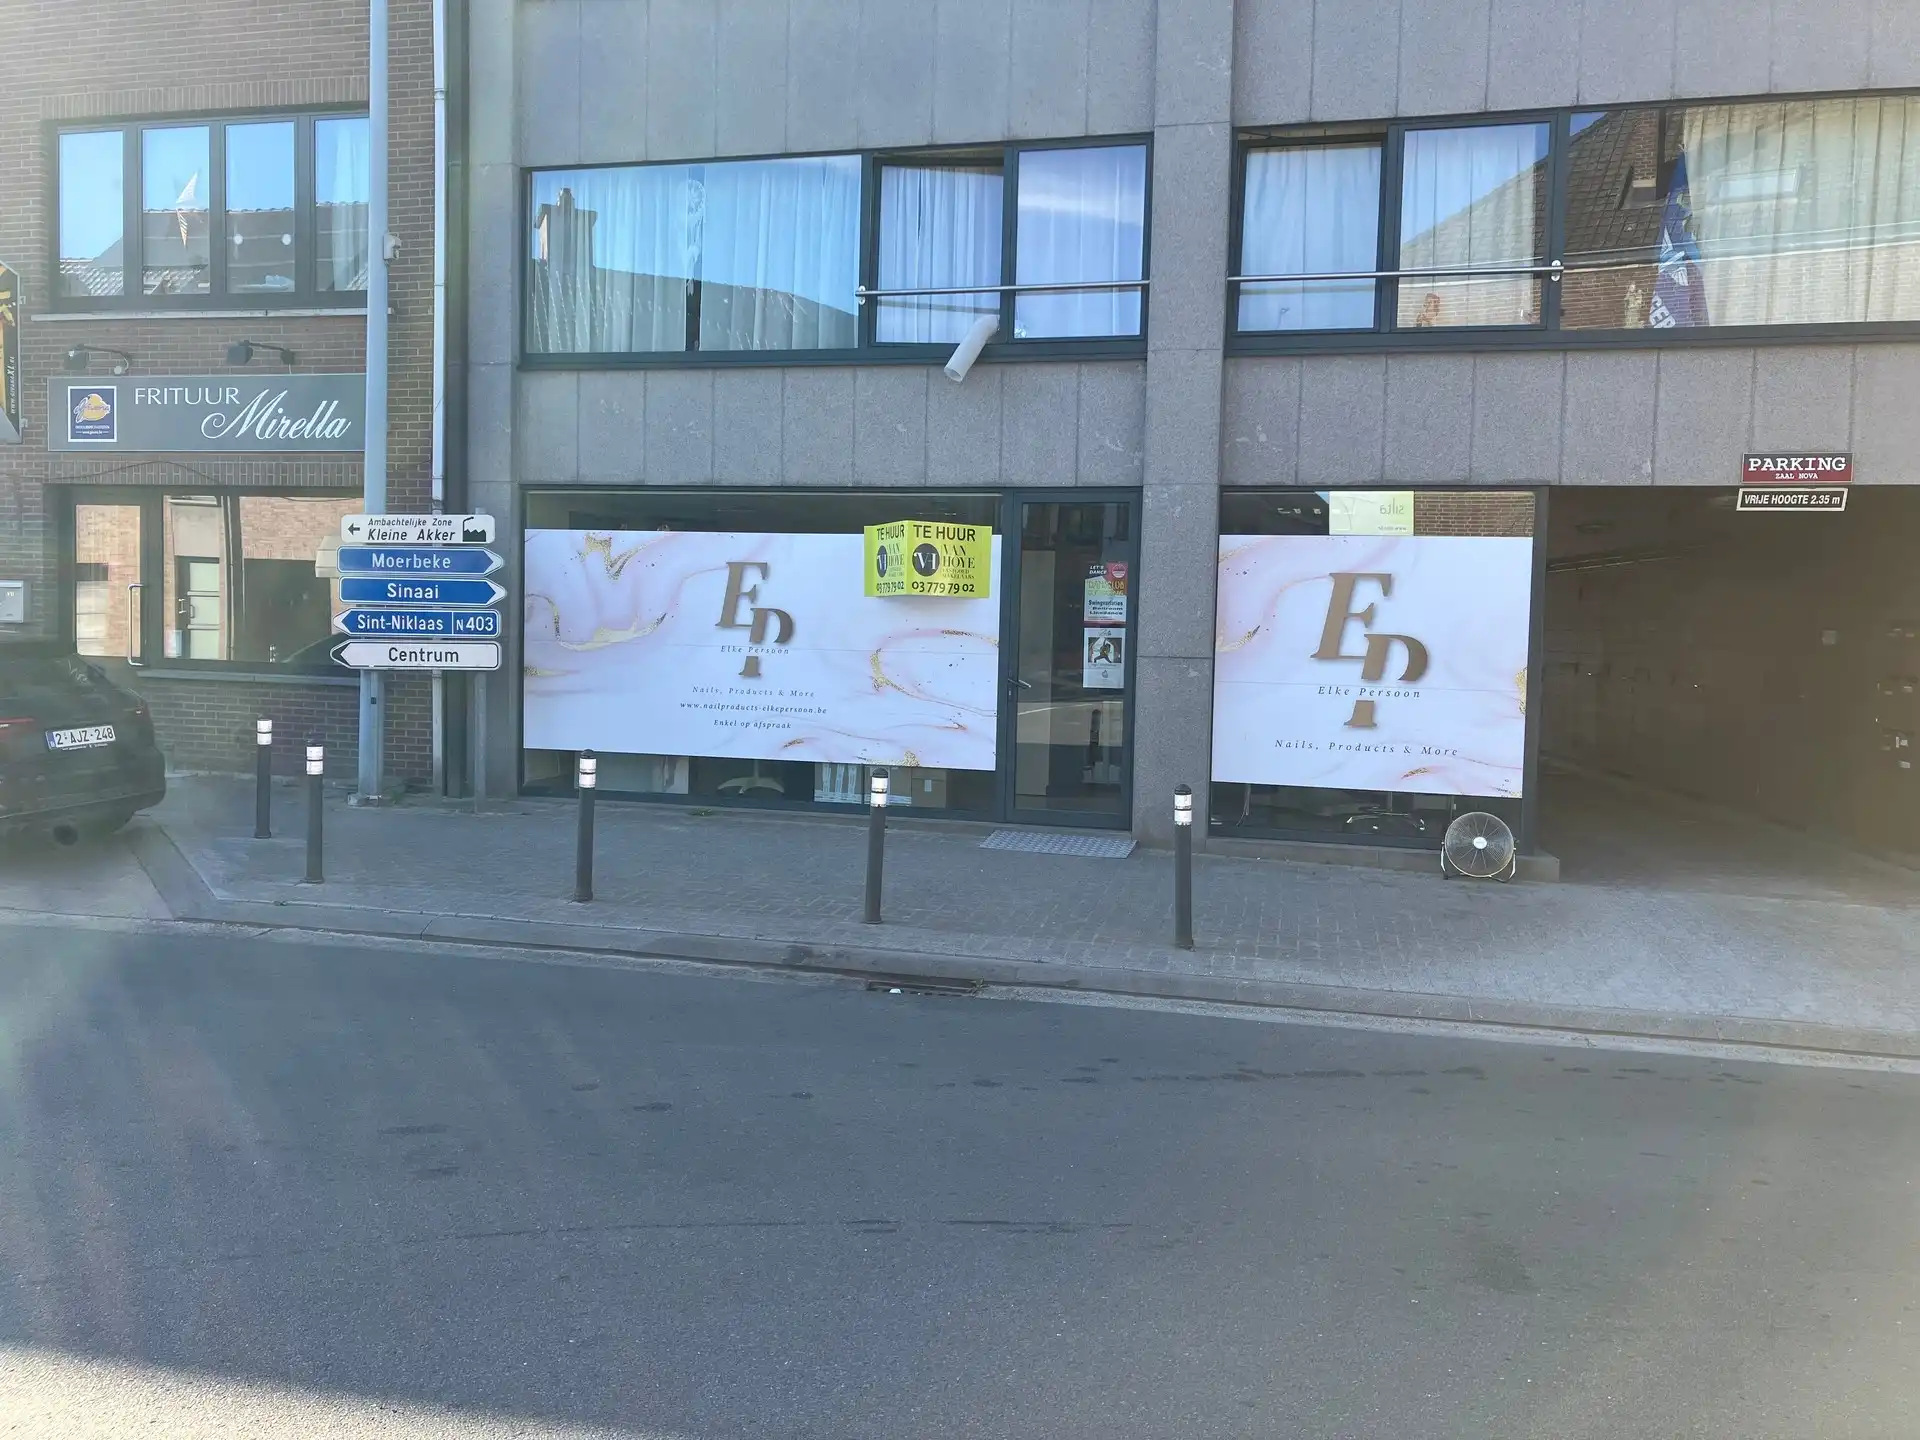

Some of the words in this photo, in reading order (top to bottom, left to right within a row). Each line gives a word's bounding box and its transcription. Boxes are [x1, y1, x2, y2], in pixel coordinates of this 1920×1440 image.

[134, 387, 241, 405] FRITUUR
[200, 388, 352, 441] Mirella
[1748, 457, 1847, 471] PARKING
[1744, 494, 1770, 504] VRIJE
[1771, 495, 1809, 504] HOOGTE
[1810, 495, 1830, 504] 2.35
[1831, 496, 1840, 504] m
[368, 518, 427, 528] Ambachtelijke
[432, 518, 453, 527] Zone
[367, 528, 408, 541] Kleine
[416, 529, 456, 541] Akker
[877, 527, 885, 540] TE
[885, 525, 905, 539] HUUR
[913, 525, 932, 539] TE
[936, 526, 976, 541] HUUR
[943, 544, 967, 556] VAN
[372, 553, 451, 569] Moerbeke
[943, 556, 976, 569] HOYE
[387, 582, 439, 599] Sinaai
[912, 582, 925, 592] 03
[927, 582, 945, 593] 779
[948, 583, 960, 594] 79
[962, 584, 975, 592] 02
[357, 614, 444, 631] Sint-Niklaas
[456, 616, 494, 632] N403
[388, 647, 459, 663] Centrum
[692, 686, 723, 694] Nails,
[729, 688, 773, 696] Products
[1318, 686, 1350, 696] Elke
[1359, 687, 1420, 698] Persoon
[680, 702, 827, 714] www.nailproducts-elkepersoon.be
[753, 721, 792, 730] afspraak
[1275, 739, 1319, 750] Nails,
[1329, 742, 1395, 753] Products
[1403, 746, 1412, 754] &
[1421, 746, 1458, 756] More
